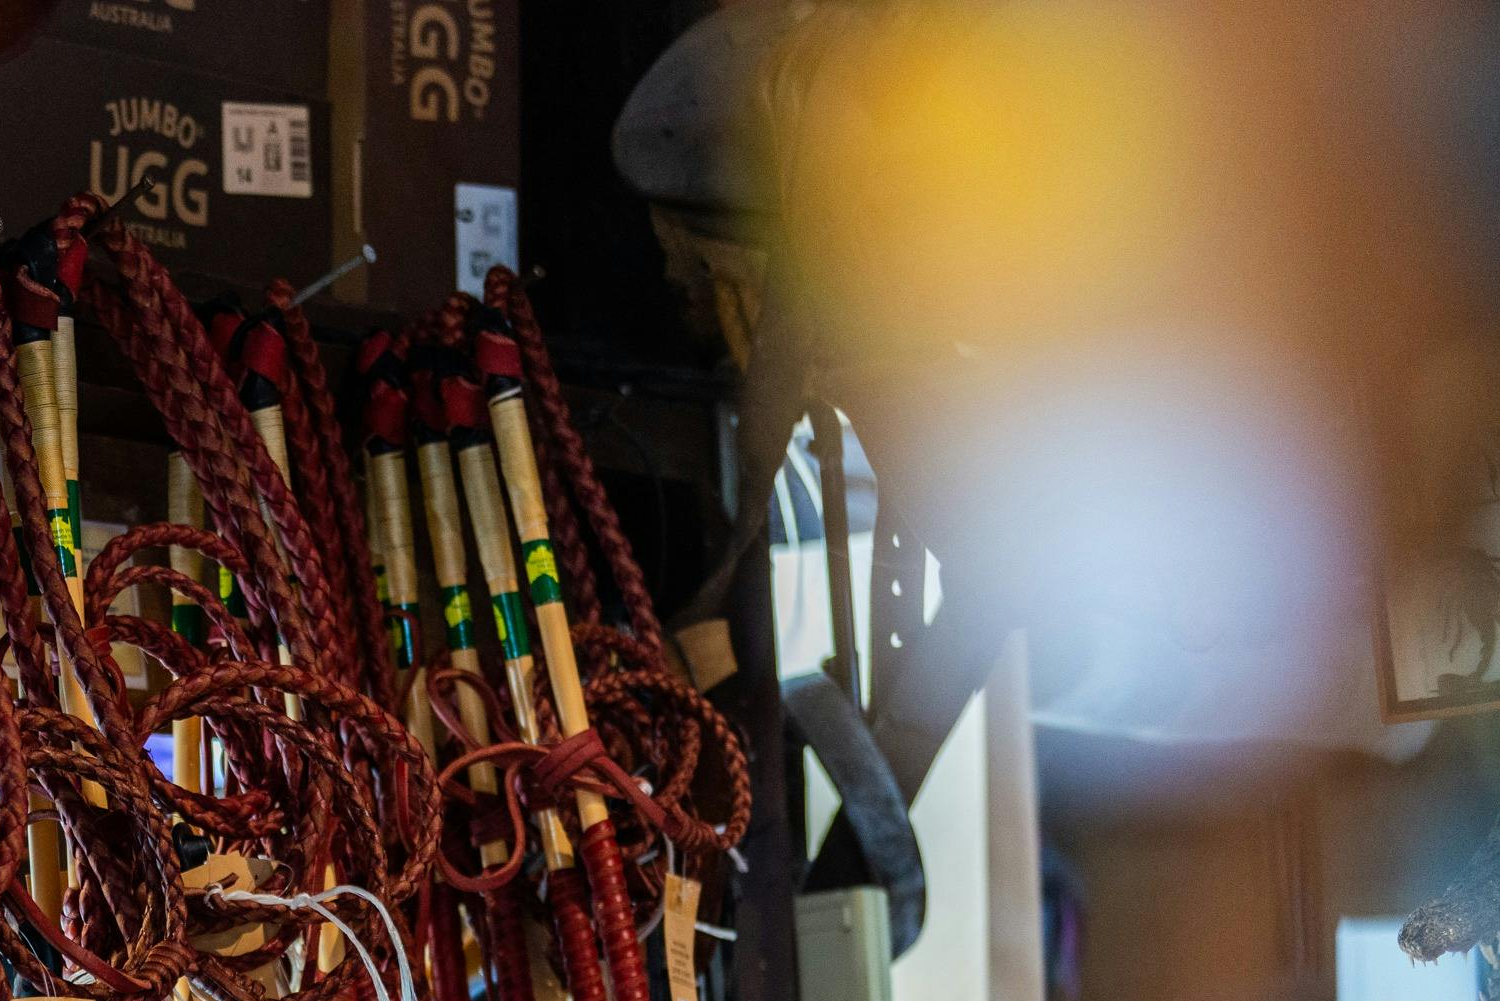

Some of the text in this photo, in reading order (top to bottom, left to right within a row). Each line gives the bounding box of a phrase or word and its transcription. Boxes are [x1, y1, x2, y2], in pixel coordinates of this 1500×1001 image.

[409, 3, 461, 123] GG
[463, 0, 496, 106] UMBO
[105, 98, 197, 149] JUMBO
[90, 140, 209, 226] UGG
